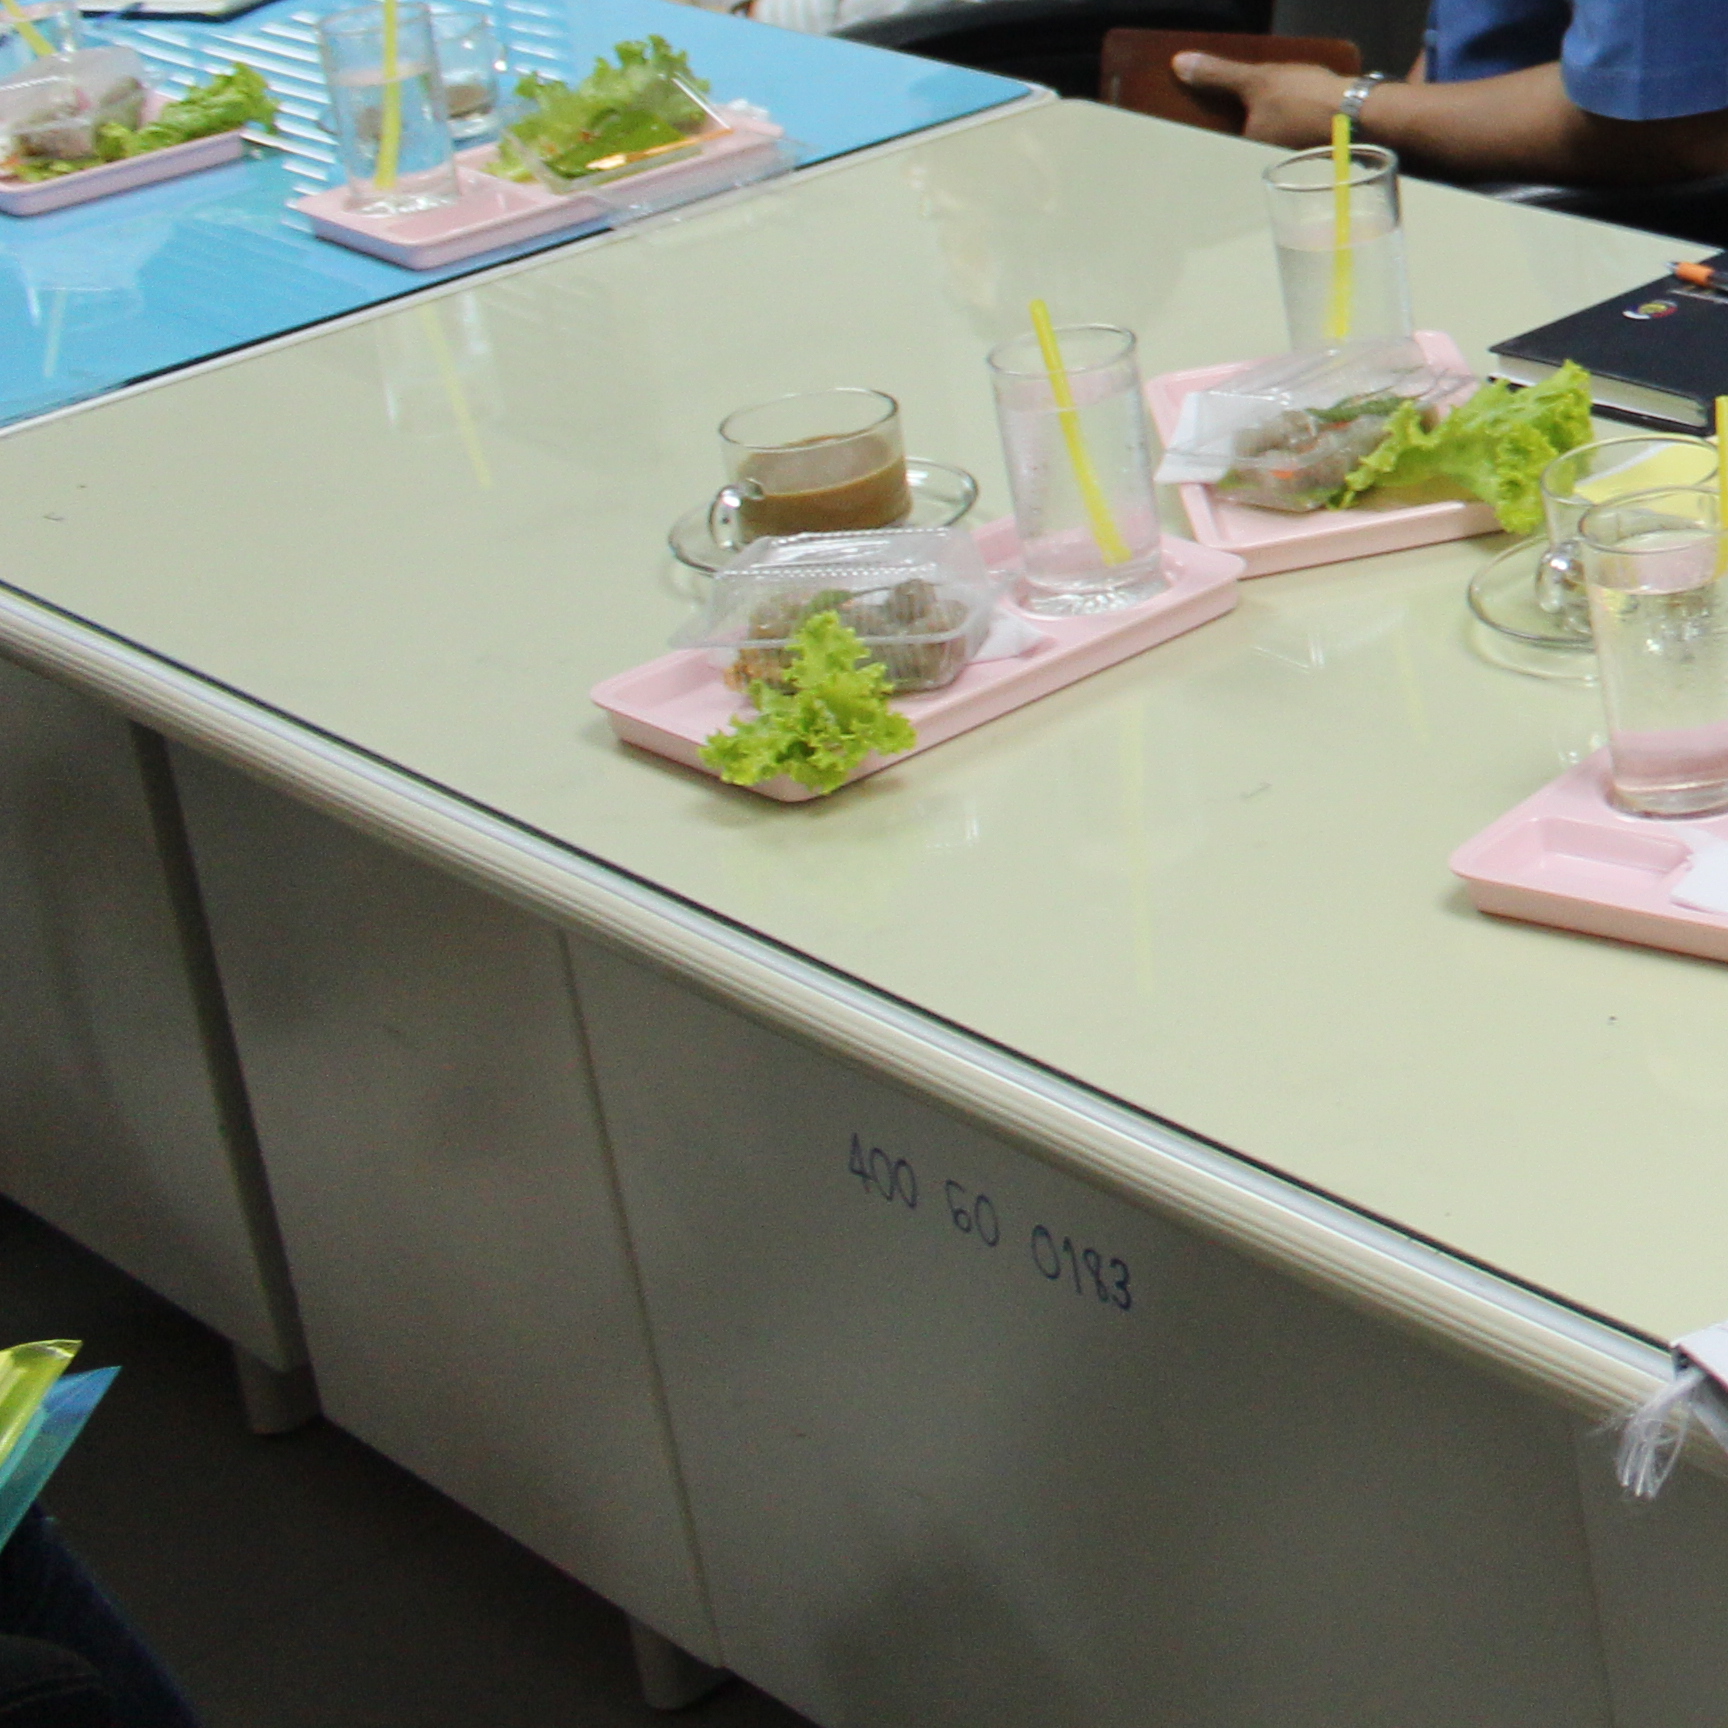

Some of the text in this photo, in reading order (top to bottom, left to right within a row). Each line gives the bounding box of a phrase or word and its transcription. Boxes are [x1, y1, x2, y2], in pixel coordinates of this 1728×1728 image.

[850, 1132, 1132, 1311] 400 60 0183
